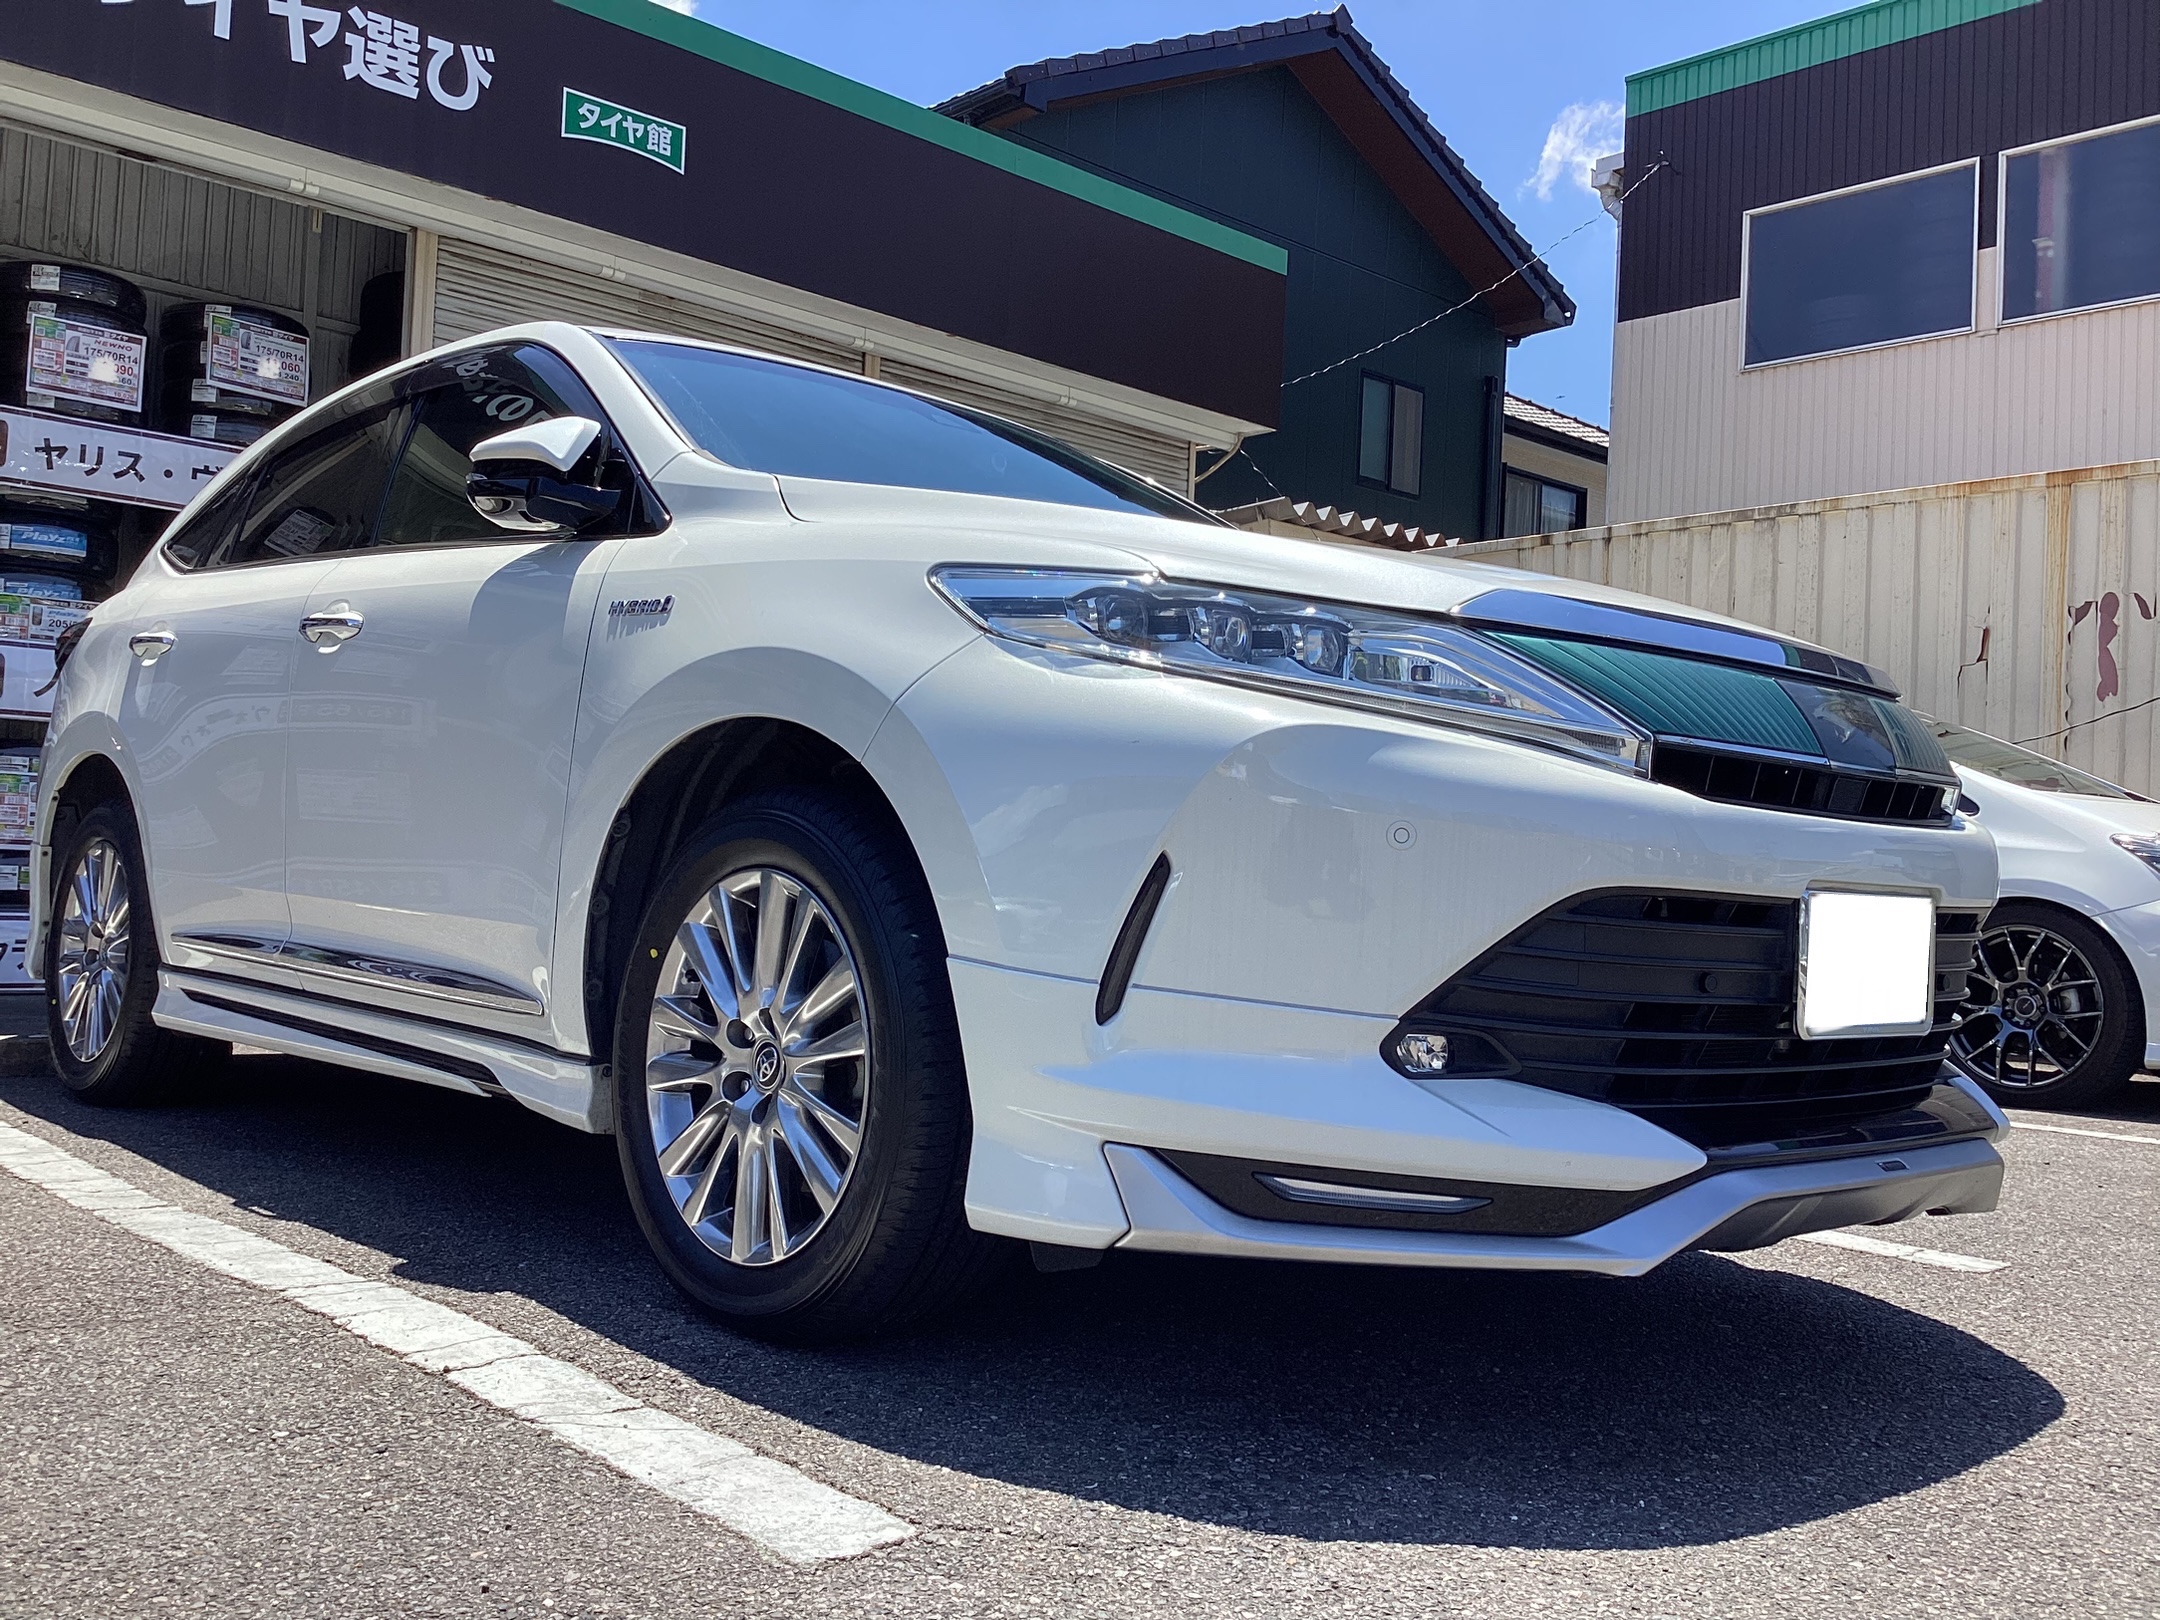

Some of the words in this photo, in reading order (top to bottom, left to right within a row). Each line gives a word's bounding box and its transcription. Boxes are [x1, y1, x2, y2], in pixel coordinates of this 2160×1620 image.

[578, 103, 672, 157] タイヤ館
[94, 339, 133, 352] NEWNO
[255, 345, 304, 363] 175/70R14
[84, 346, 138, 365] 175/70R14
[608, 598, 662, 617] HYBRID
